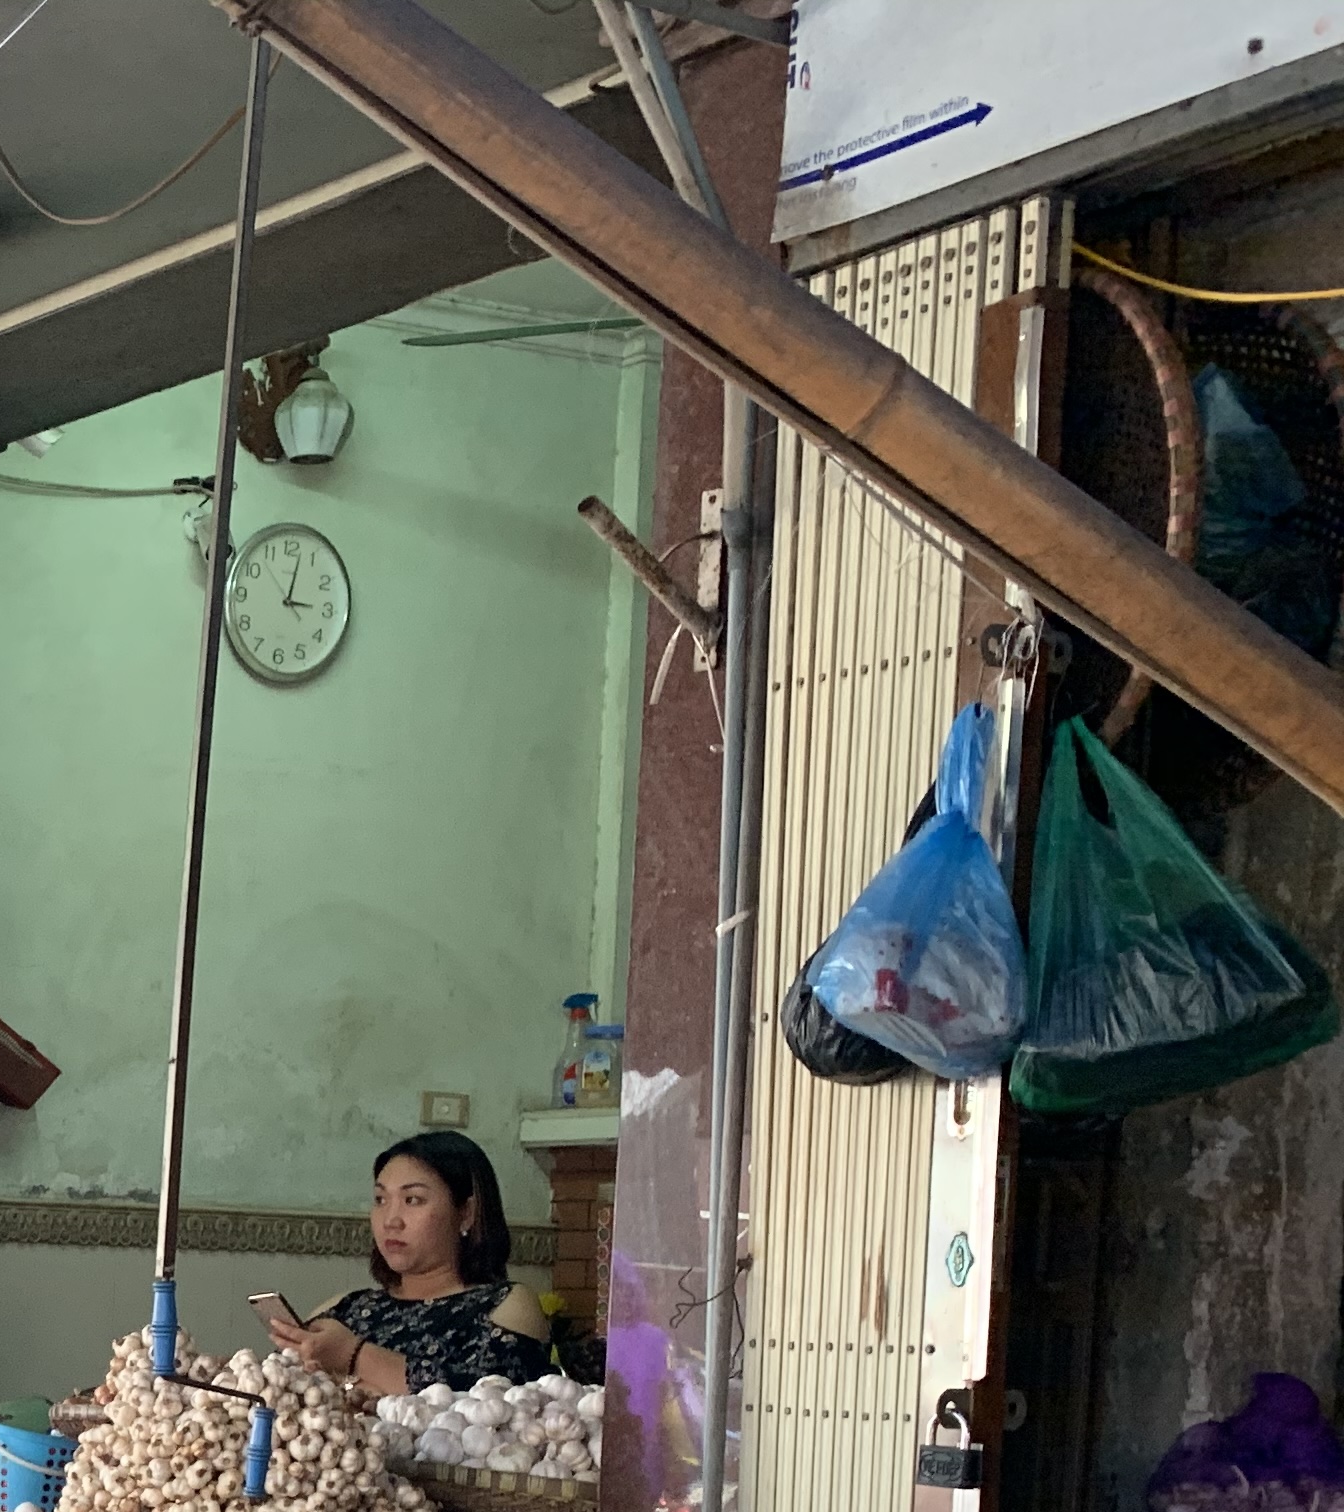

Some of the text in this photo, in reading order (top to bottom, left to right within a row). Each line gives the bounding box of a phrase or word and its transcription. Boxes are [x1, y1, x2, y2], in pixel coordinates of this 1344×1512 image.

[813, 148, 834, 164] the
[837, 122, 900, 157] protective
[902, 112, 926, 132] film
[929, 96, 969, 120] within
[283, 540, 300, 557] 12
[245, 561, 261, 579] 10
[318, 574, 331, 591] 2
[235, 586, 247, 602] 9
[321, 602, 333, 619] 3
[238, 614, 251, 631] 8
[311, 628, 323, 643] 4
[253, 636, 265, 653] 7
[293, 643, 306, 660] 5
[272, 648, 285, 665] 6
